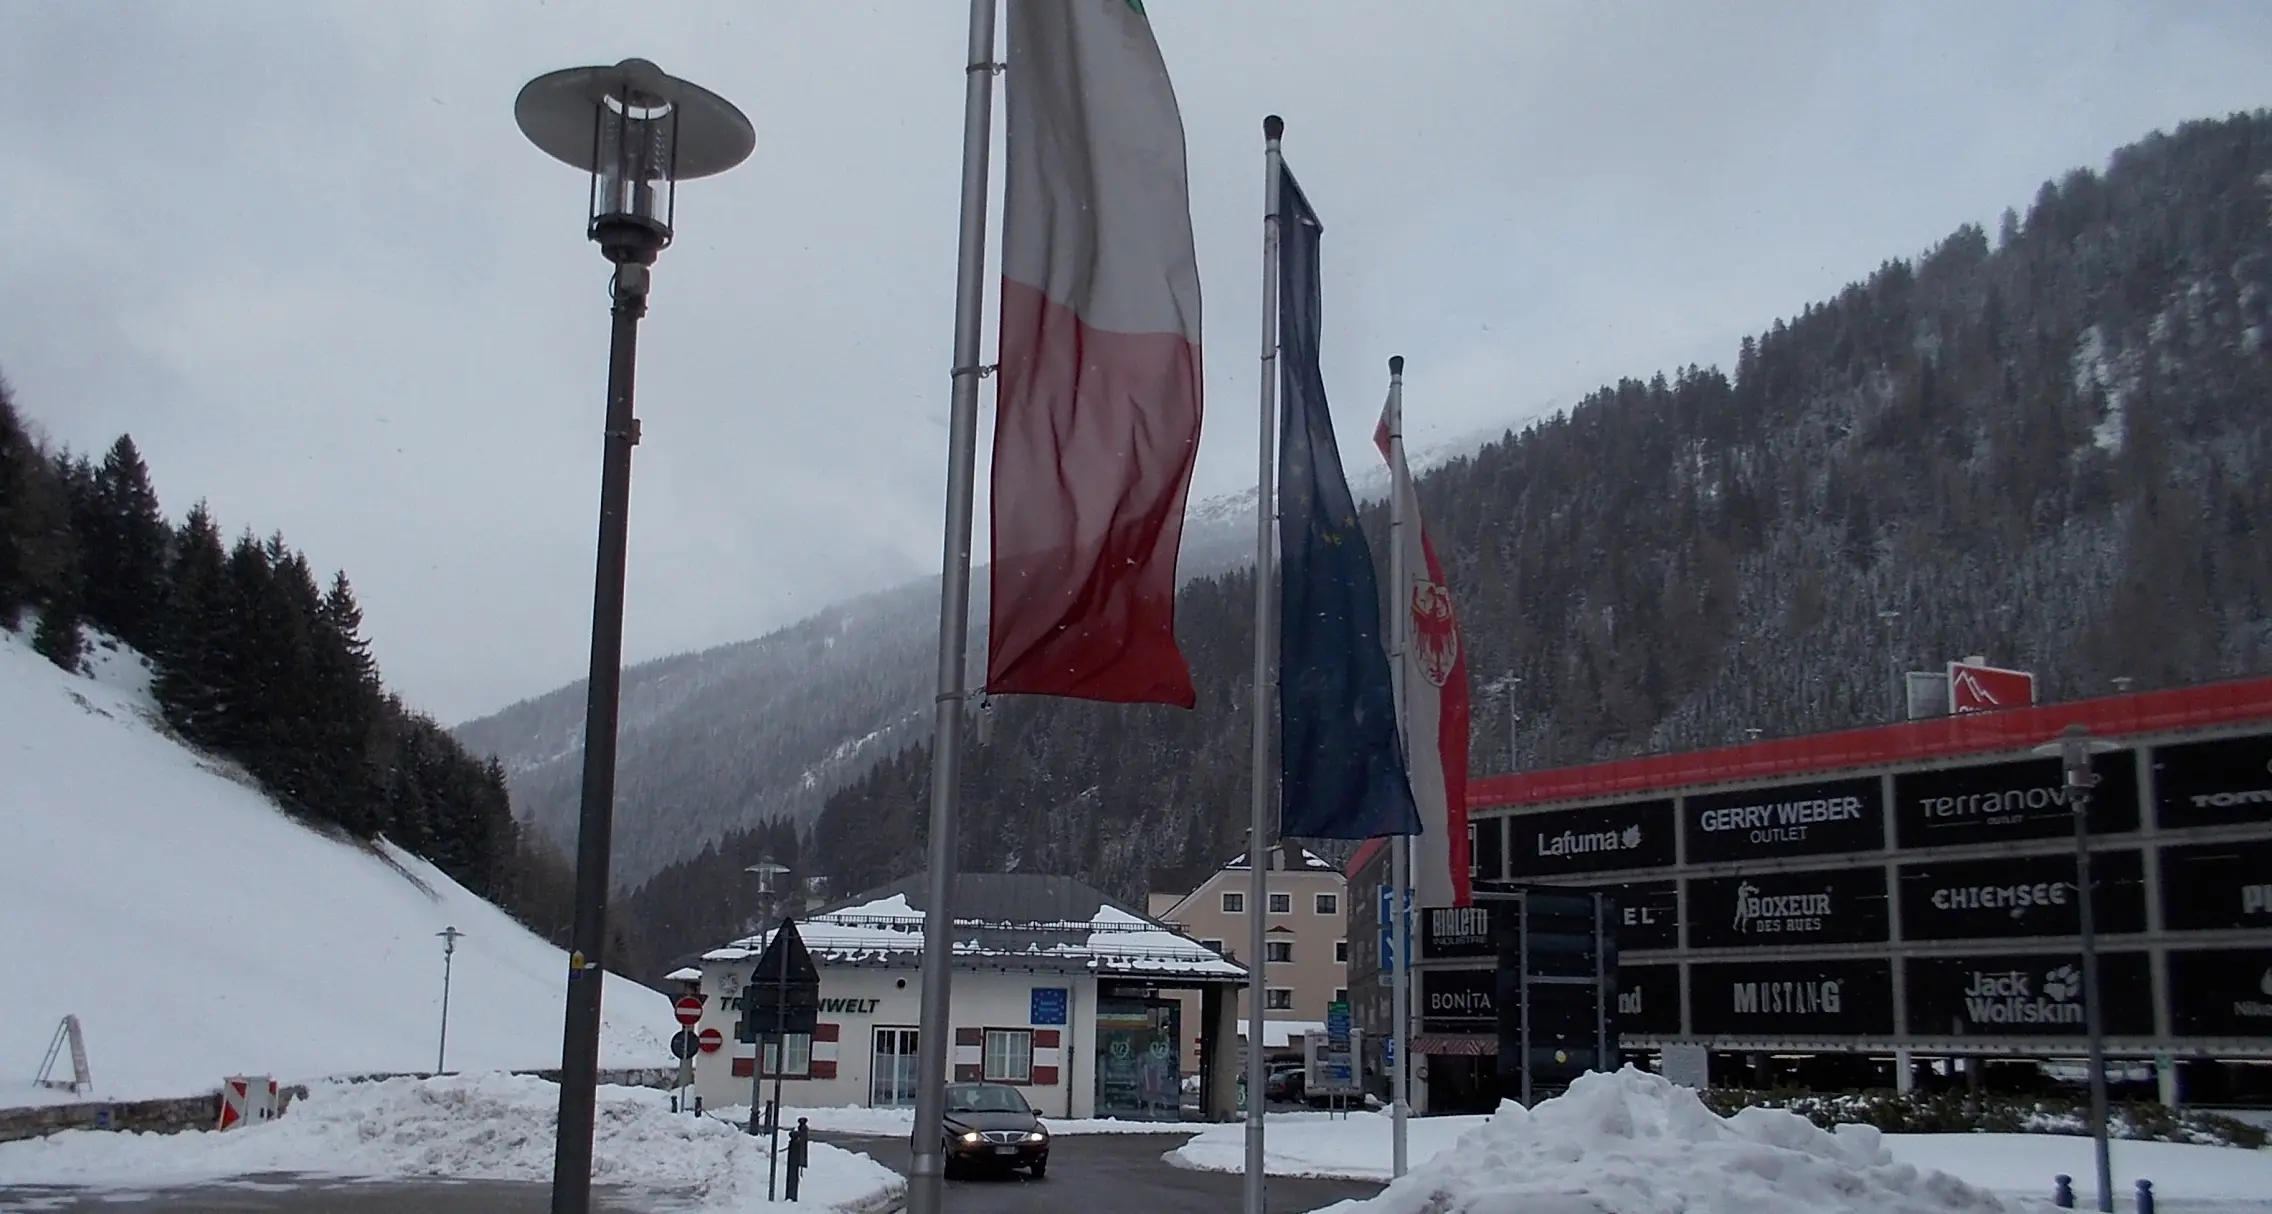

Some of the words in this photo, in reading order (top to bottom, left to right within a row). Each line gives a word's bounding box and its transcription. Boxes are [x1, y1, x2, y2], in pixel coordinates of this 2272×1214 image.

[1700, 804, 1773, 832] GERRY
[1775, 796, 1861, 825] WEBER
[1918, 787, 2069, 818] Terranov
[1537, 829, 1619, 856] Lafuma
[1749, 825, 1808, 844] OUTLET
[1747, 894, 1832, 918] BOXEUR
[1930, 881, 2067, 910] CHIEMSEE
[1756, 918, 1781, 933] DES
[1785, 917, 1822, 932] RUES
[1964, 970, 2030, 997] Jack
[1733, 981, 1840, 1014] MUSTANG
[1964, 996, 2083, 1024] Wolfskin
